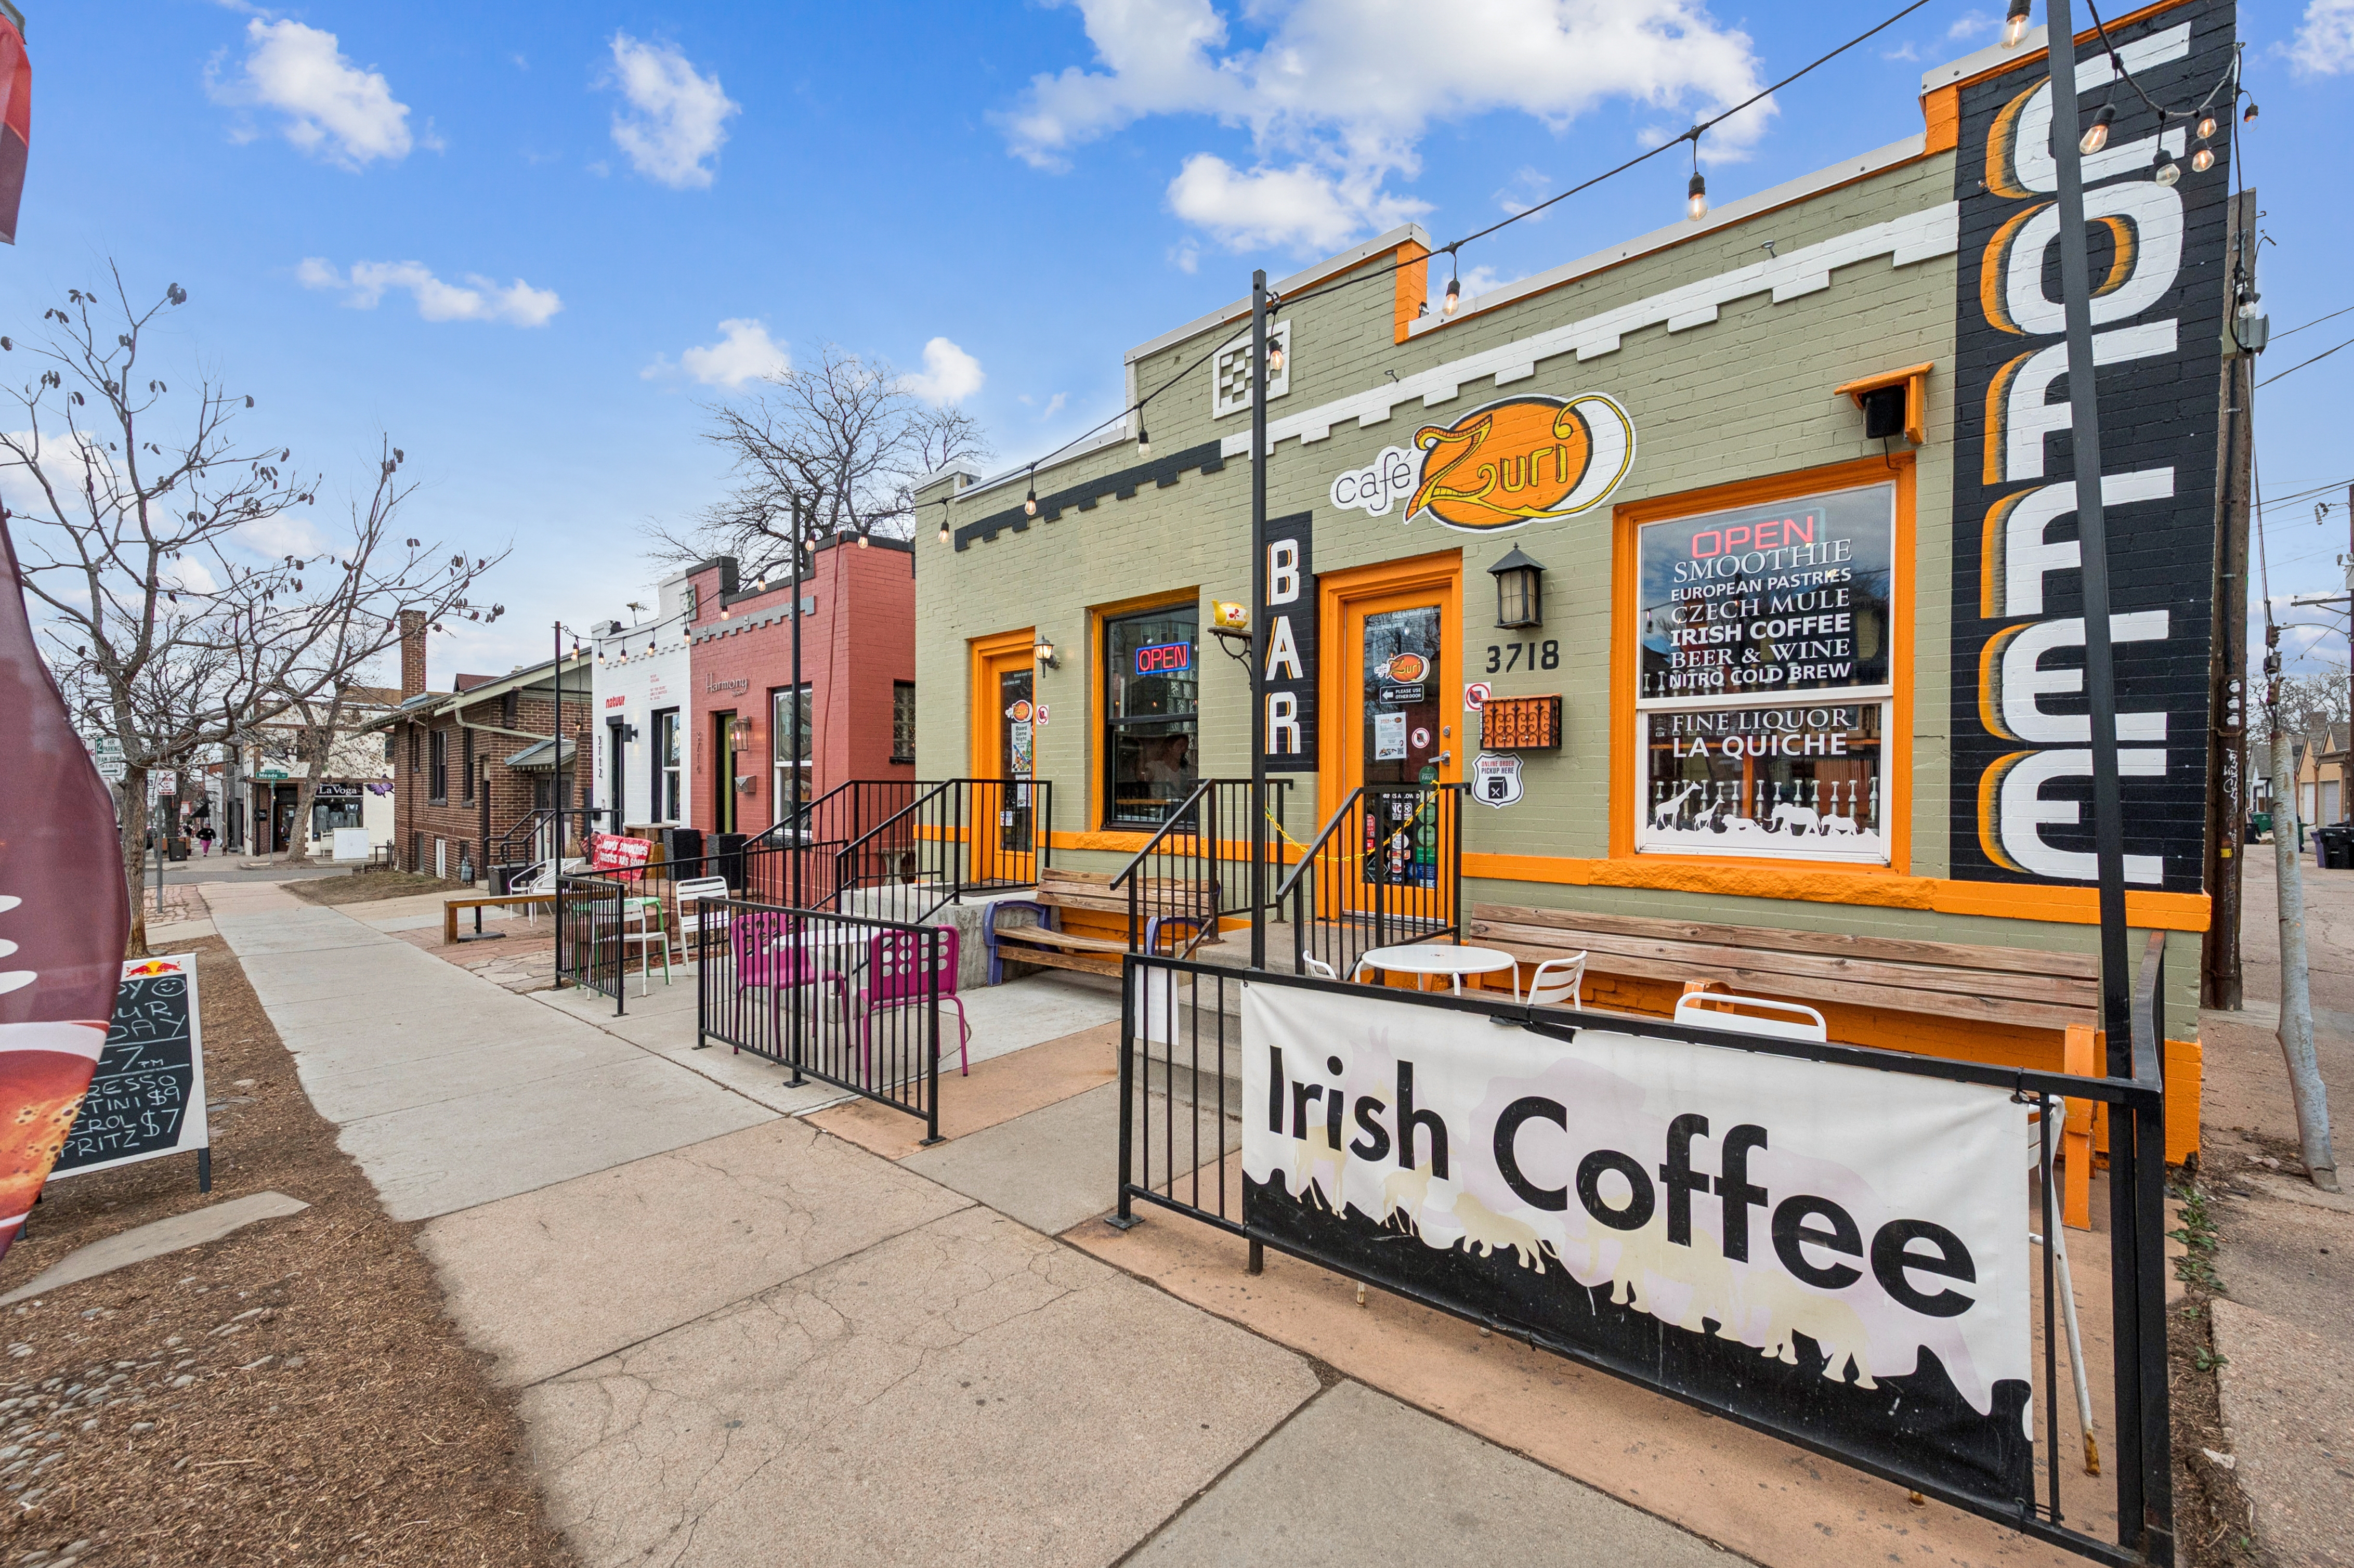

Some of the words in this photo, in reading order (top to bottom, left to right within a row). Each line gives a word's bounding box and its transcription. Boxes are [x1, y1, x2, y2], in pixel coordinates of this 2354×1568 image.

[1405, 413, 1575, 522] Zuri
[1978, 21, 2192, 885] COFFEE
[1692, 515, 1814, 559] OPEN
[1673, 538, 1852, 584] SMOOTHIE
[1671, 578, 1762, 602] EUROPEAN
[1768, 567, 1852, 591] PASTRIES
[1671, 597, 1760, 625] CZECH
[1770, 588, 1850, 613] MULE
[1670, 623, 1742, 647] IRISH
[1750, 612, 1851, 641] COFFEE
[1138, 645, 1187, 672] OPEN
[1265, 538, 1302, 755] BAR
[1485, 639, 1560, 674] 3718
[1670, 648, 1733, 669] BEER
[1741, 647, 1761, 664] &
[1769, 638, 1851, 661] WINE
[1387, 657, 1421, 678] Zuri
[1669, 670, 1724, 688] NITRO
[1730, 667, 1783, 685] COLD
[1790, 662, 1851, 680] BREW
[705, 672, 748, 694] Harmony
[606, 695, 625, 709] natuur
[1672, 713, 1729, 732] FINE
[1739, 708, 1852, 733] LIQUOR
[97, 740, 102, 751] 2
[1673, 737, 1710, 758] LA
[1721, 732, 1847, 761] QUICHE
[333, 786, 357, 796] Voga
[84, 1075, 176, 1098] RESSO
[79, 1096, 141, 1116] TINI
[70, 1114, 136, 1135] EROL
[140, 1108, 180, 1138] $7
[60, 1130, 140, 1157] PRITZ
[1267, 1044, 1452, 1183] Irish
[1491, 1094, 1978, 1319] Coffee
